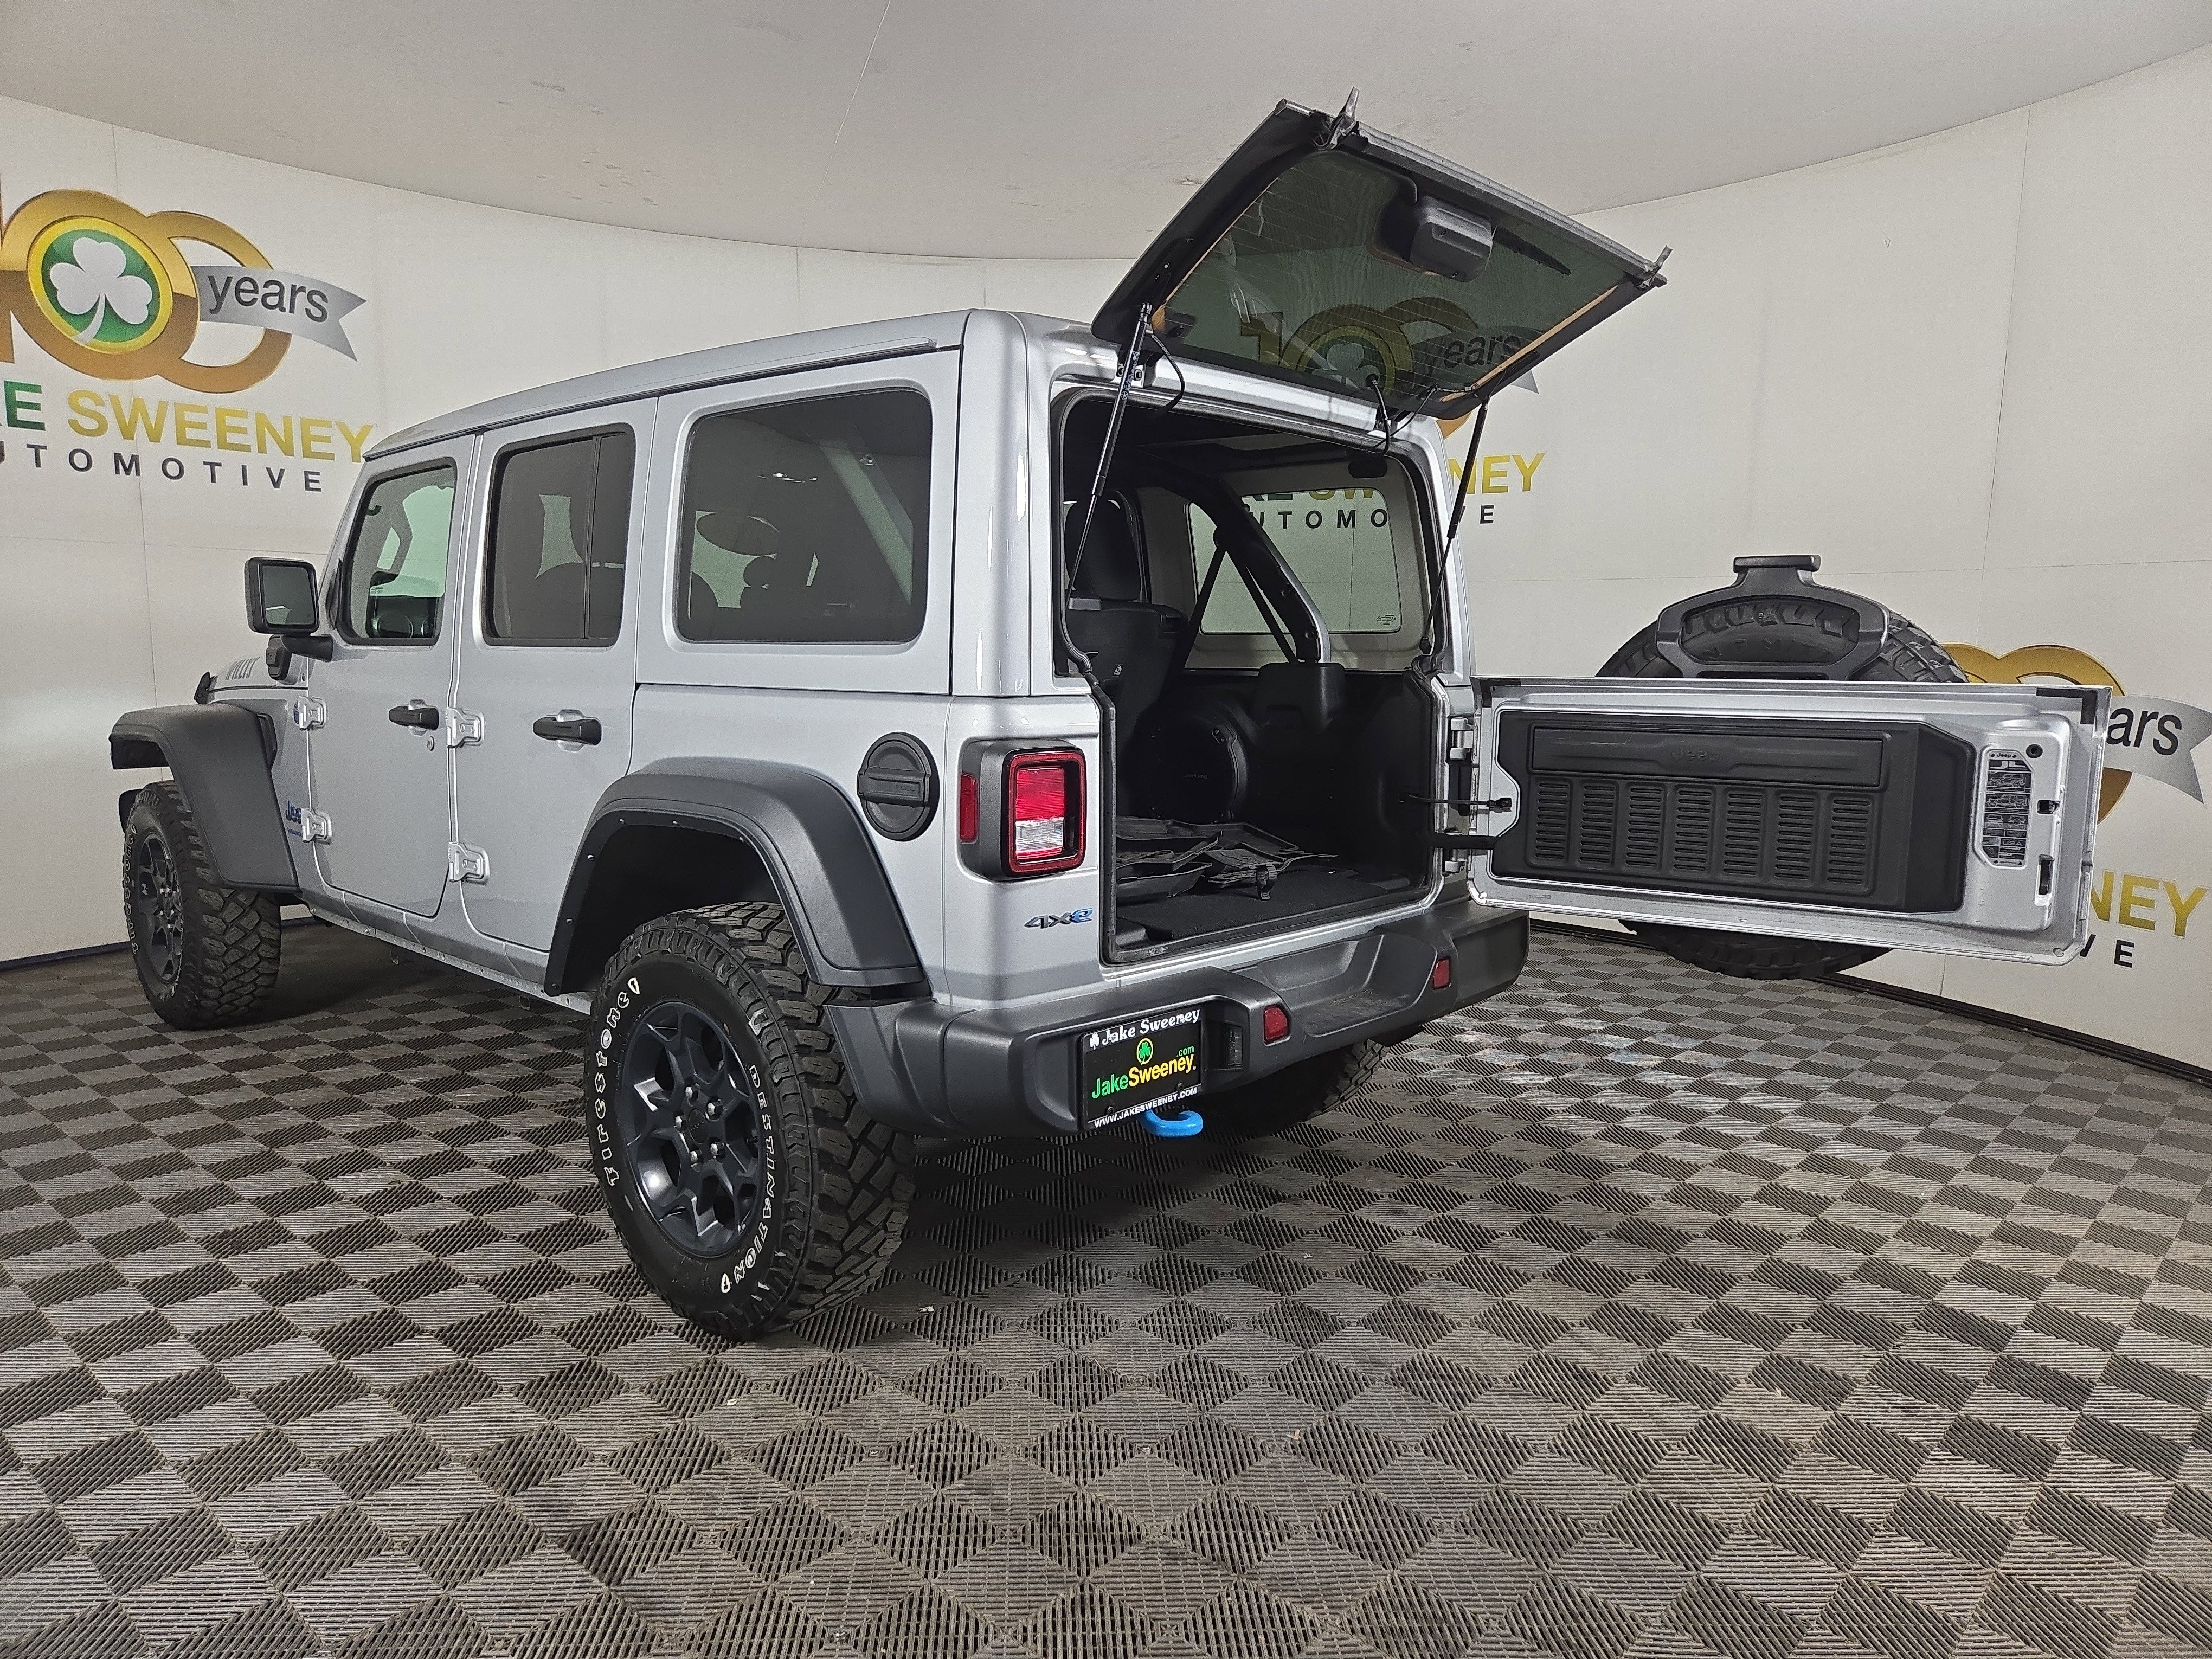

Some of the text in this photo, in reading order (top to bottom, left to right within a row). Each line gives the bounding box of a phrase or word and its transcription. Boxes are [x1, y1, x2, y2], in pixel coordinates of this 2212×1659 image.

[207, 274, 330, 323] years
[67, 389, 375, 464] SWEENEY
[1102, 1009, 1200, 1045] Jake Sweeney
[1094, 1086, 1198, 1128] WWW.JAKESWEENEY.COM
[733, 1064, 776, 1284] DESTINATION
